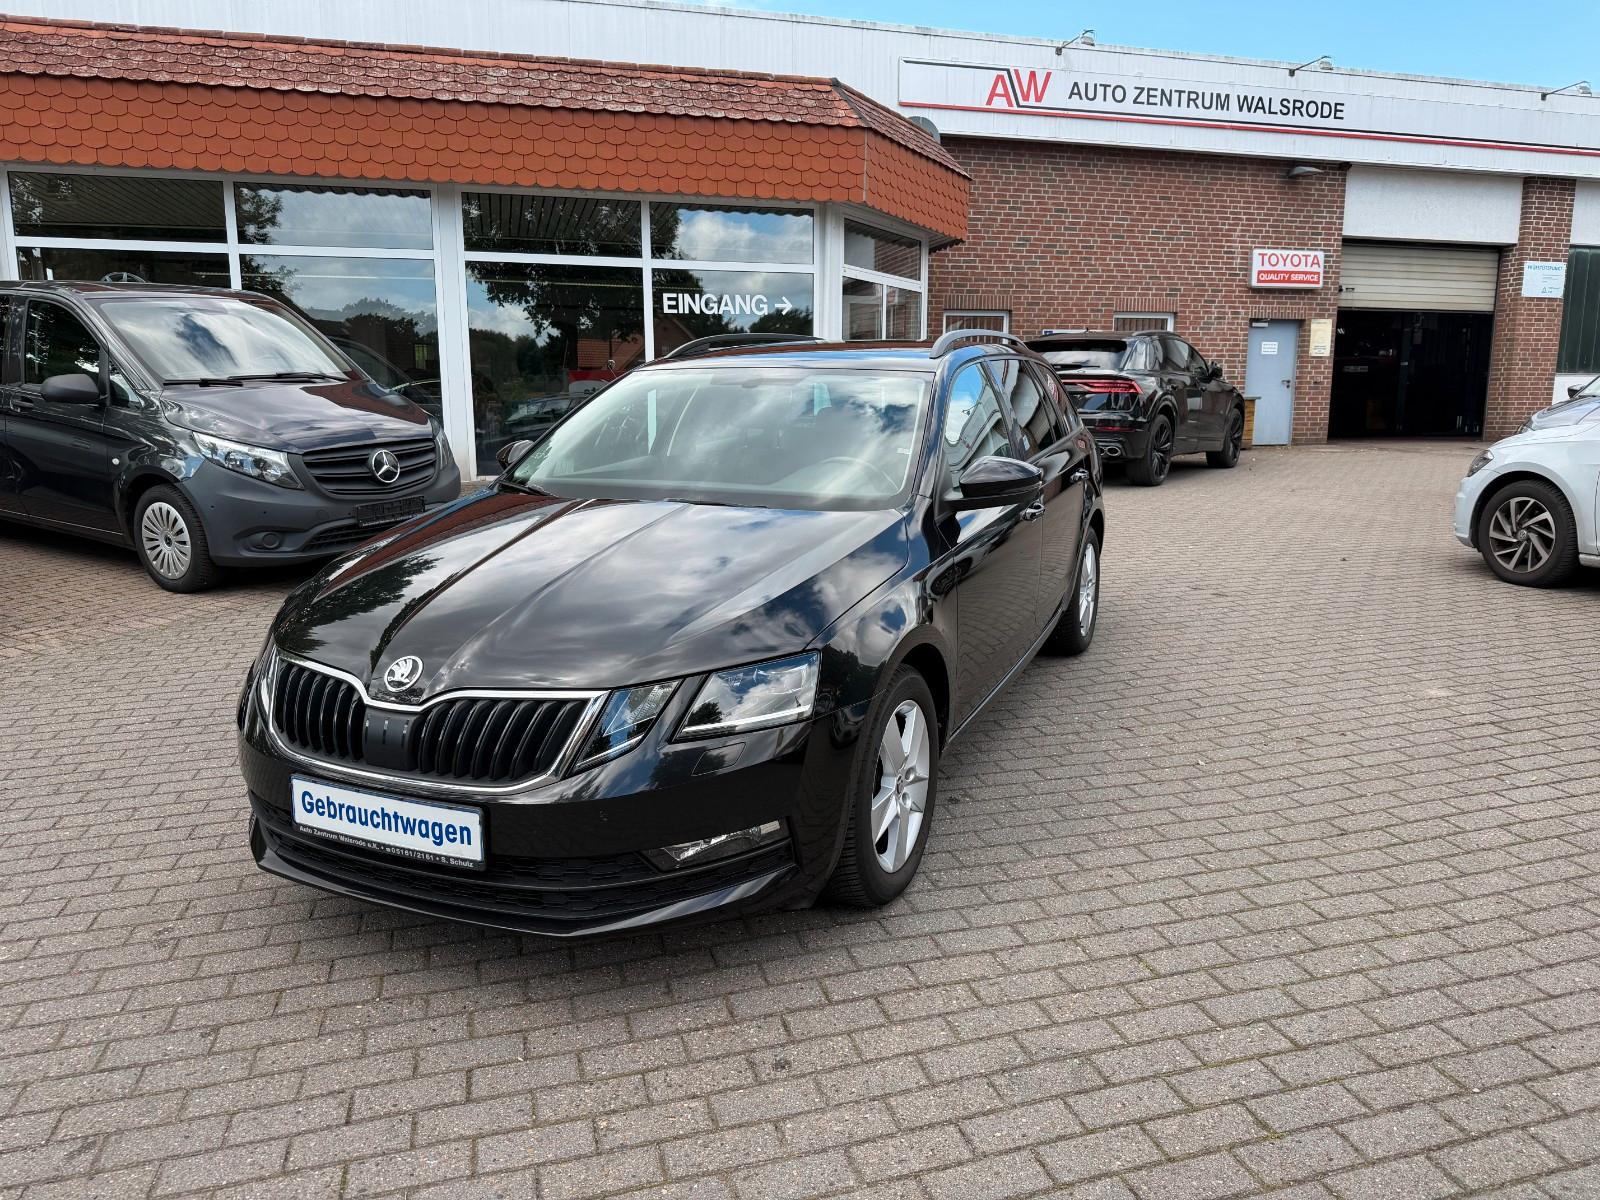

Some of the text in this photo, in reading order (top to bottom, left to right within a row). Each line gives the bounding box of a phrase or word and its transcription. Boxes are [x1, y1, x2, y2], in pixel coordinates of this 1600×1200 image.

[985, 69, 1052, 107] AW
[1068, 81, 1344, 120] AUTO ZENTRUM WALSRODE
[1258, 252, 1320, 268] TOYOTA
[1259, 272, 1319, 281] QUALITY SERVICE
[662, 292, 768, 316] EINGANG
[301, 790, 472, 846] Gebrauchtwagen
[299, 825, 313, 834] Auto
[313, 828, 338, 840] Zentrum
[338, 834, 366, 847] Walsrode
